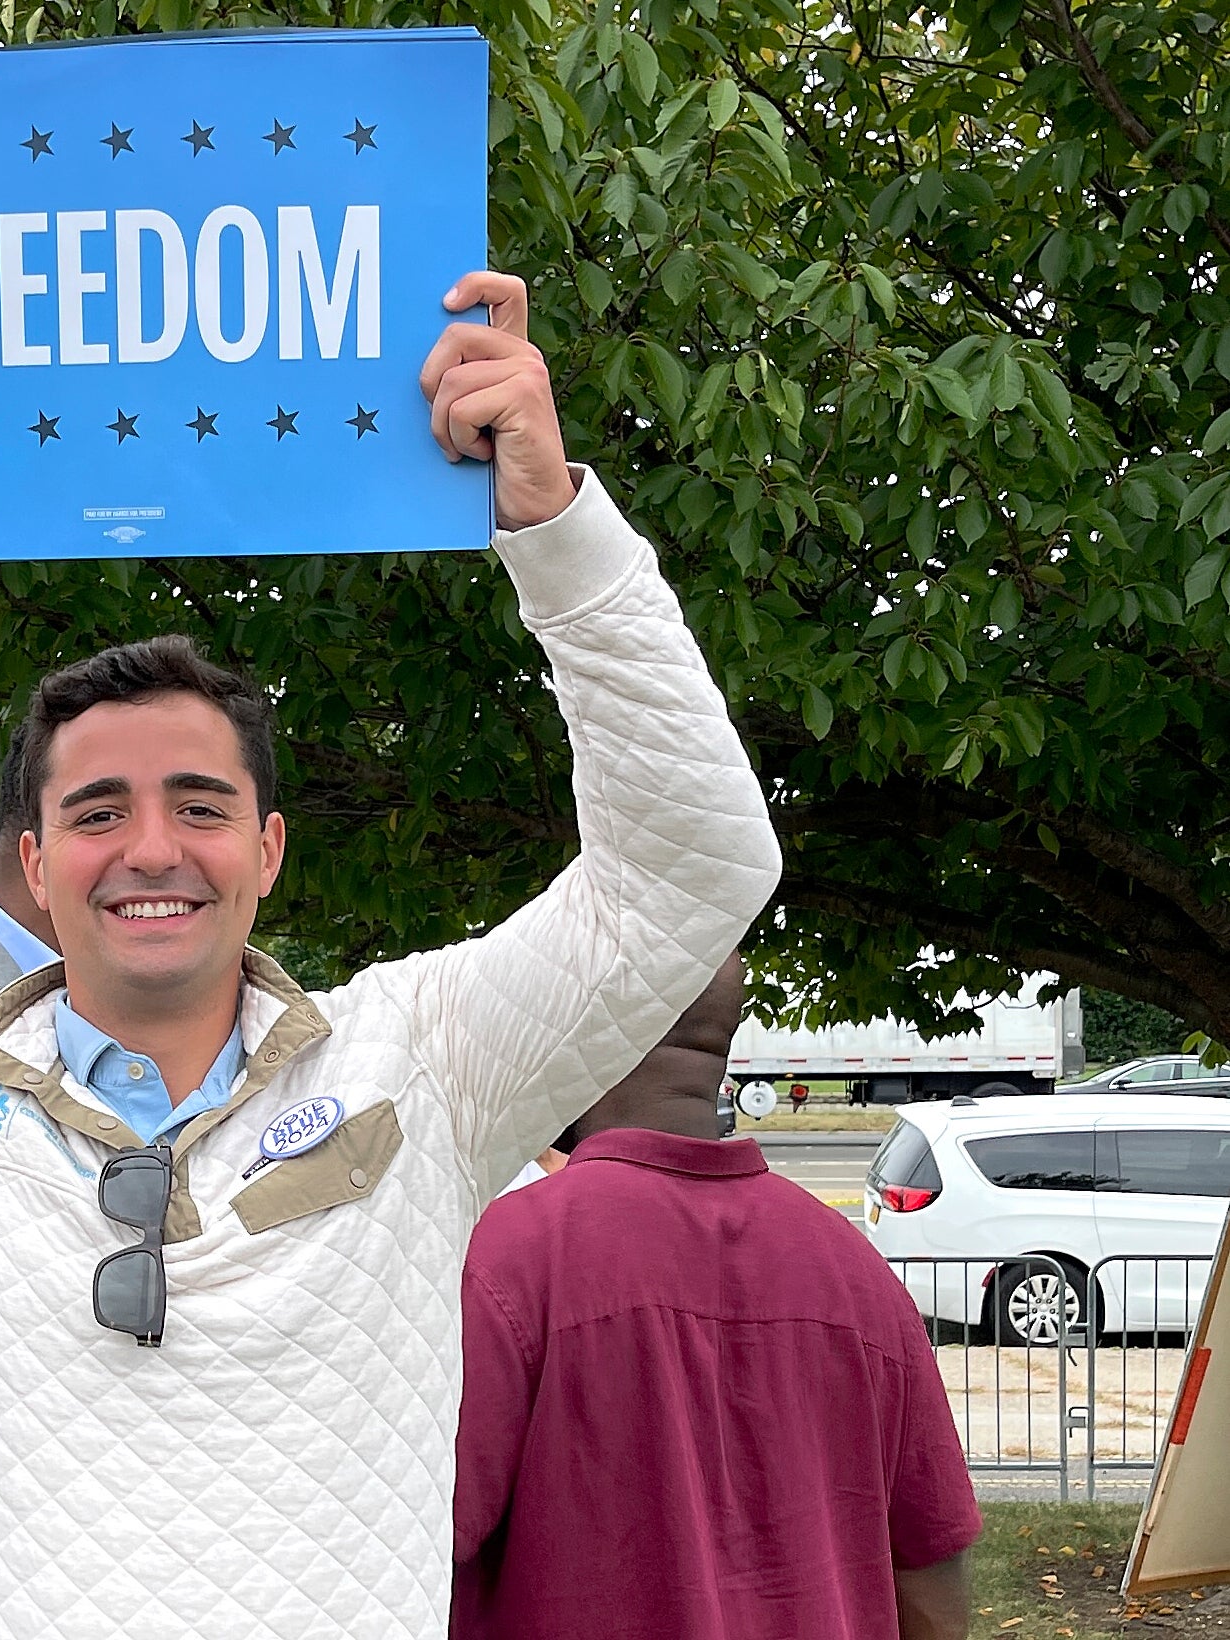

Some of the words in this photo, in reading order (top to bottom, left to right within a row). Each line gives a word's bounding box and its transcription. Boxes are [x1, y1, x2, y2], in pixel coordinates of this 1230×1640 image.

[269, 1099, 325, 1132] VOTE
[272, 1109, 326, 1145] BLUE
[275, 1114, 330, 1152] 2024
